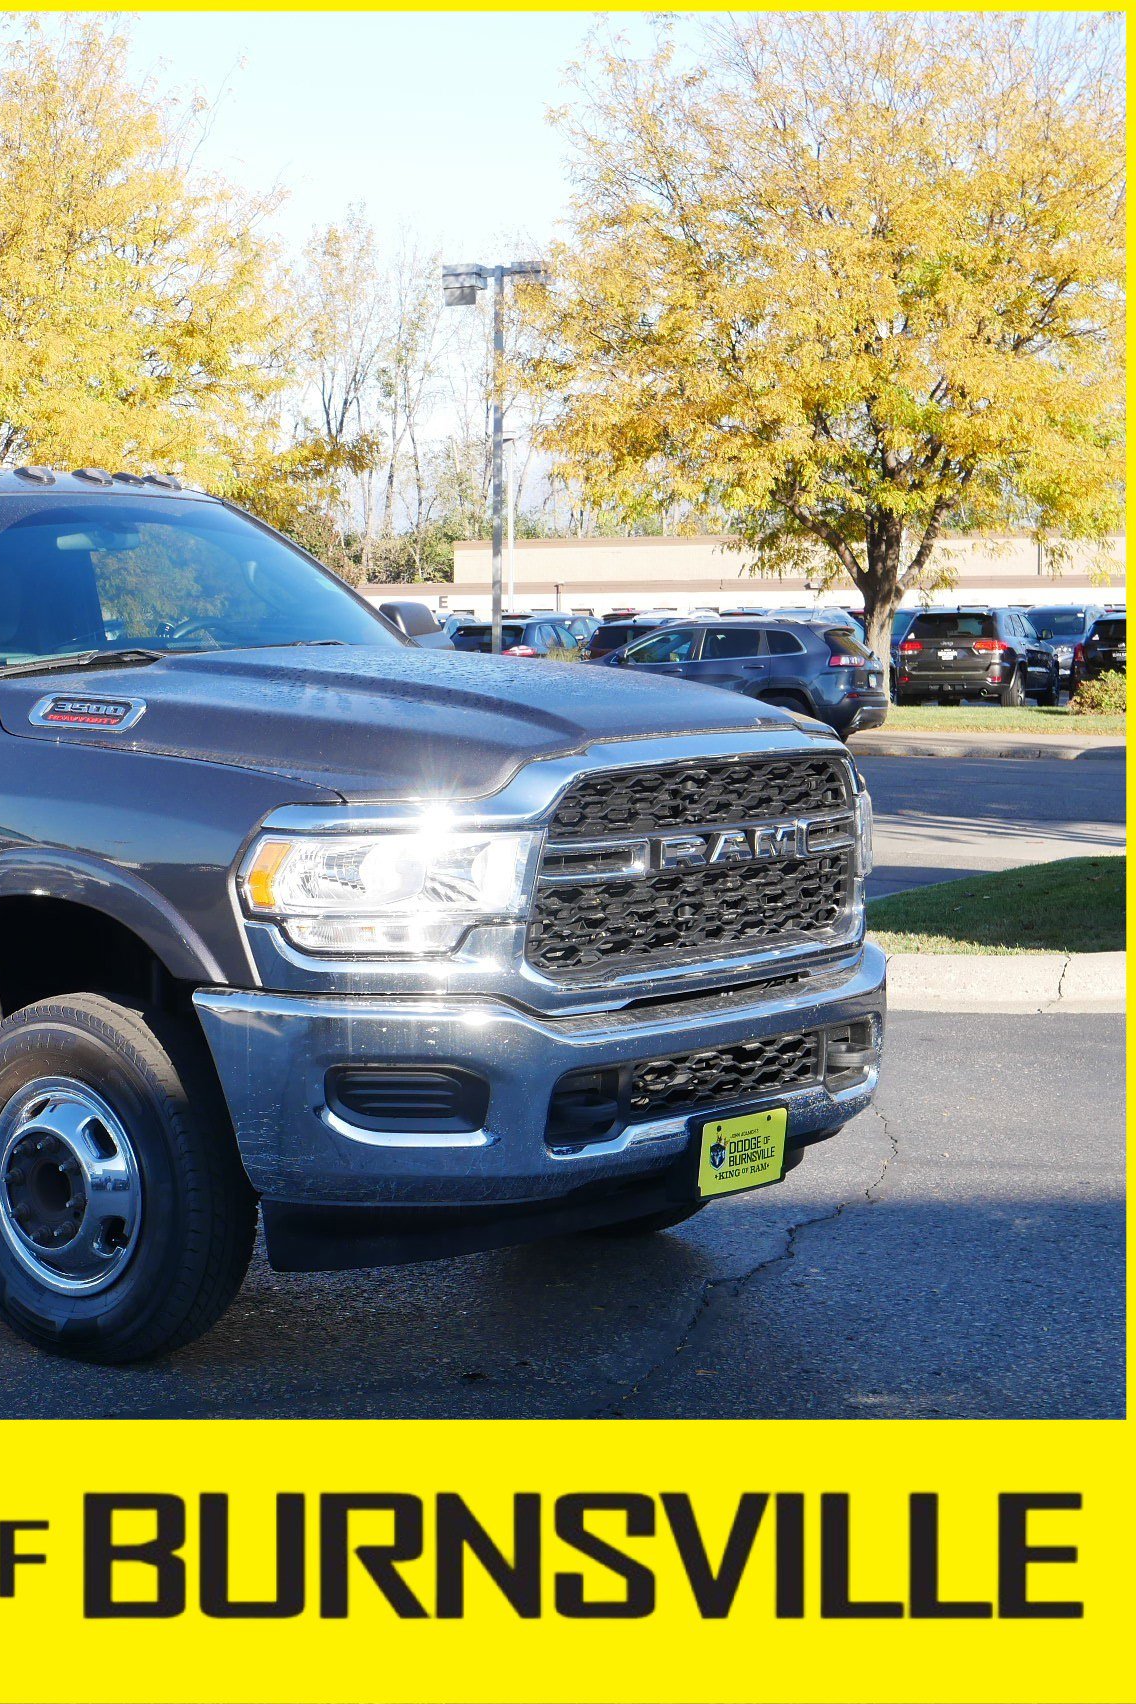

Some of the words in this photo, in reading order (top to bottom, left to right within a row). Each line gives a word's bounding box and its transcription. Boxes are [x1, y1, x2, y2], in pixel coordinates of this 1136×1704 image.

[439, 596, 448, 608] E
[54, 702, 126, 716] 3500
[661, 825, 796, 869] RAM
[729, 1136, 762, 1155] DODGE
[763, 1136, 770, 1144] OF
[729, 1146, 775, 1167] BURNSVILLE
[718, 1169, 741, 1181] KING
[750, 1162, 767, 1175] RAM
